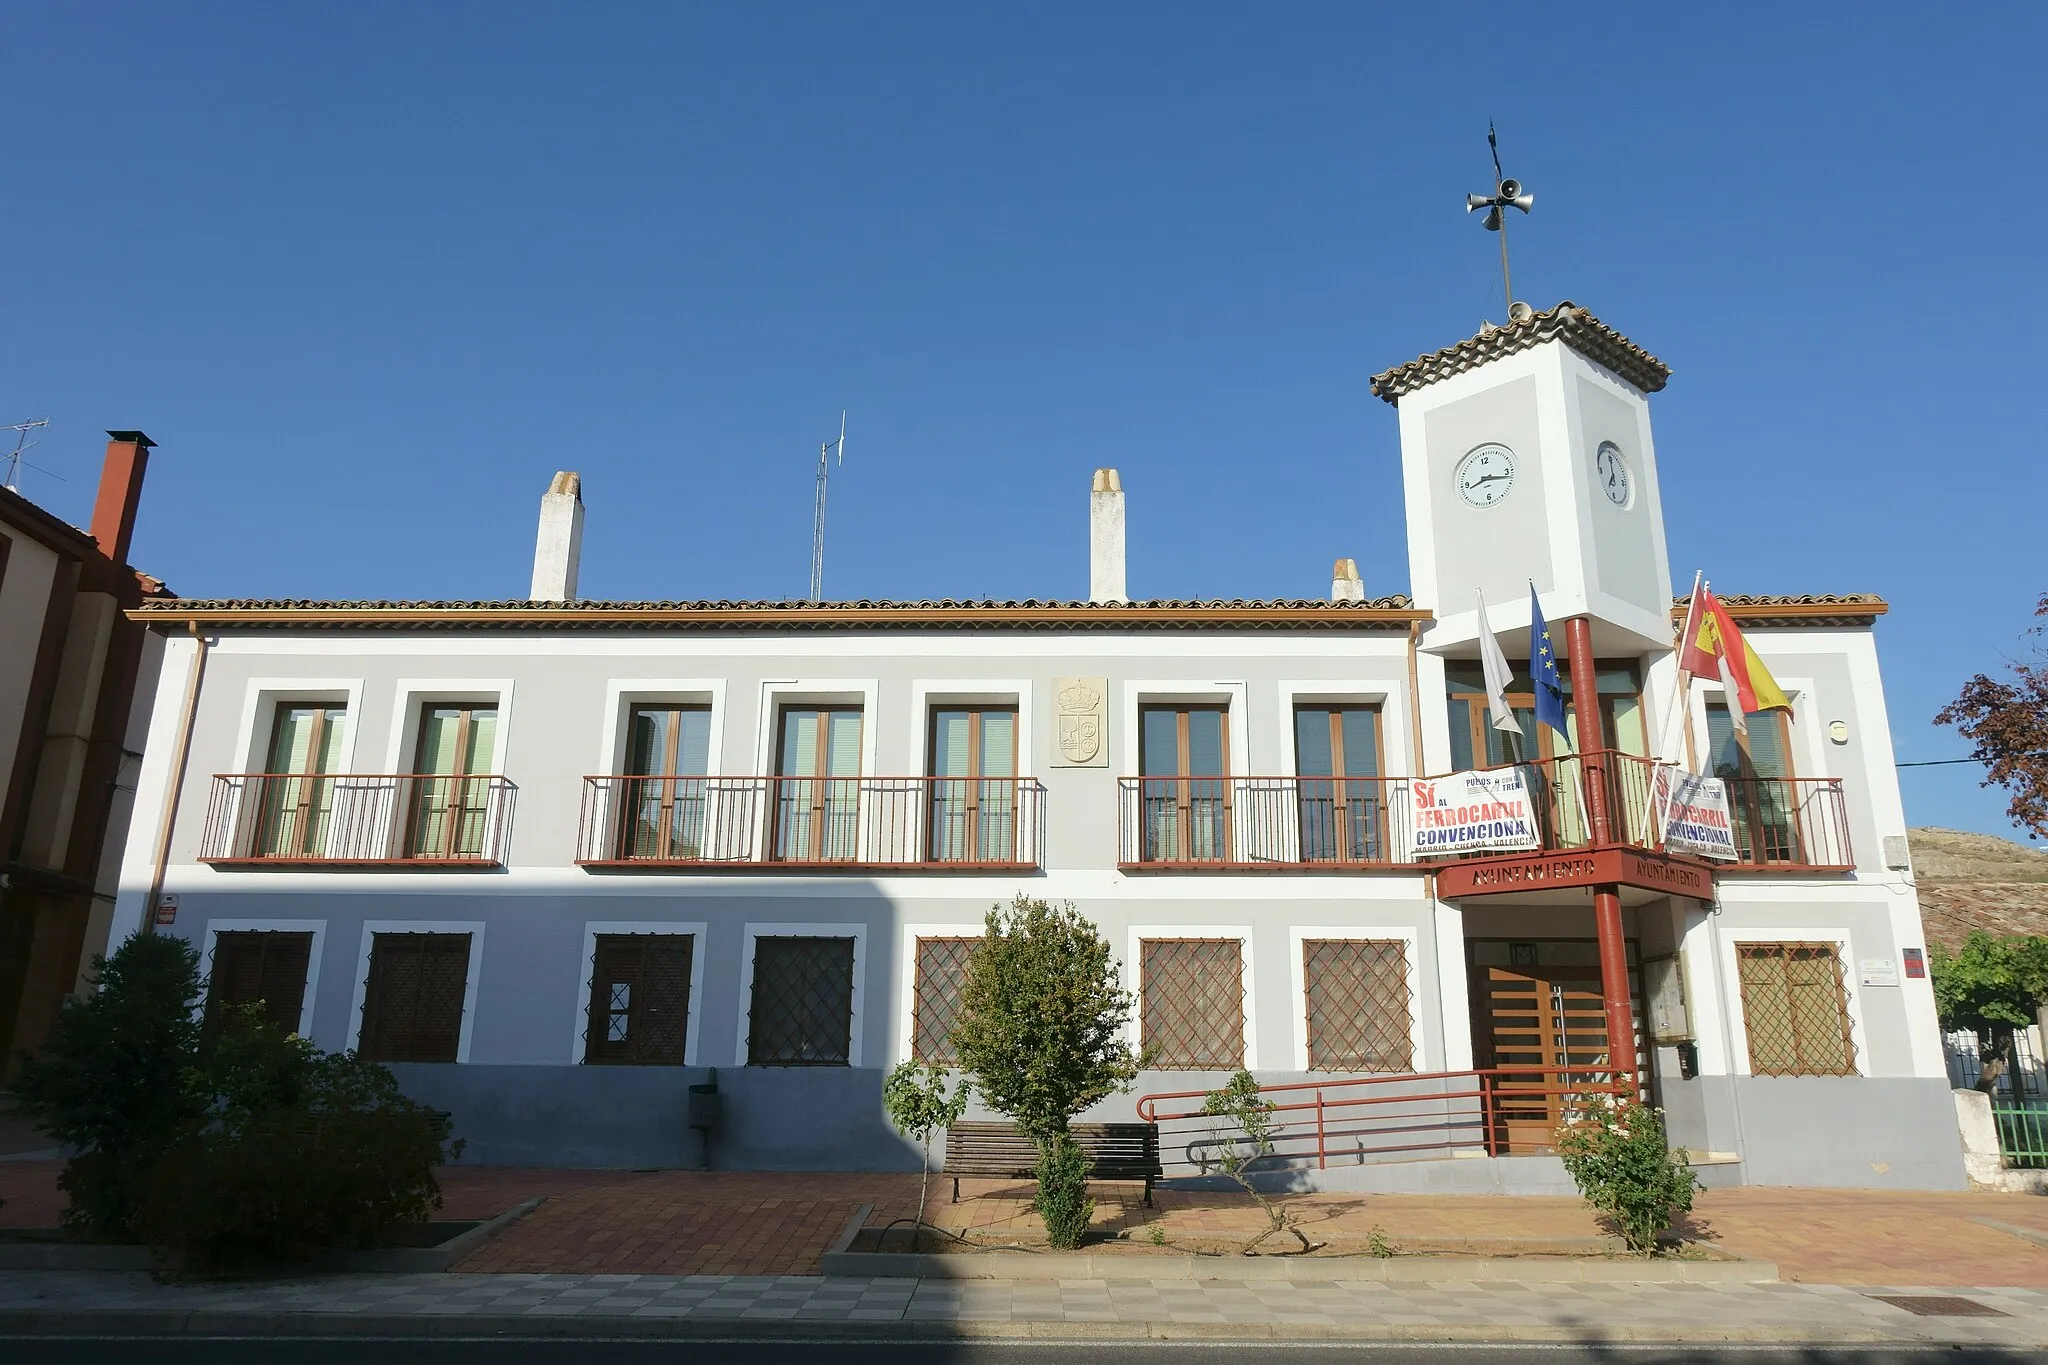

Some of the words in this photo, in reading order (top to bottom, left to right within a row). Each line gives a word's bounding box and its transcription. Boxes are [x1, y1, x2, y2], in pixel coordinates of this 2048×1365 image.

[1481, 456, 1489, 465] 12
[1504, 468, 1510, 476] 3
[1464, 481, 1470, 489] 9
[1486, 493, 1492, 501] 6
[1466, 777, 1491, 787] PUEOS
[1502, 782, 1520, 791] TREN
[1438, 798, 1448, 807] AL
[1416, 820, 1527, 846] CONVENCIONA
[1472, 859, 1594, 885] AYUNTAMIENTO
[1636, 860, 1700, 888] AYUNTAMIENTO
